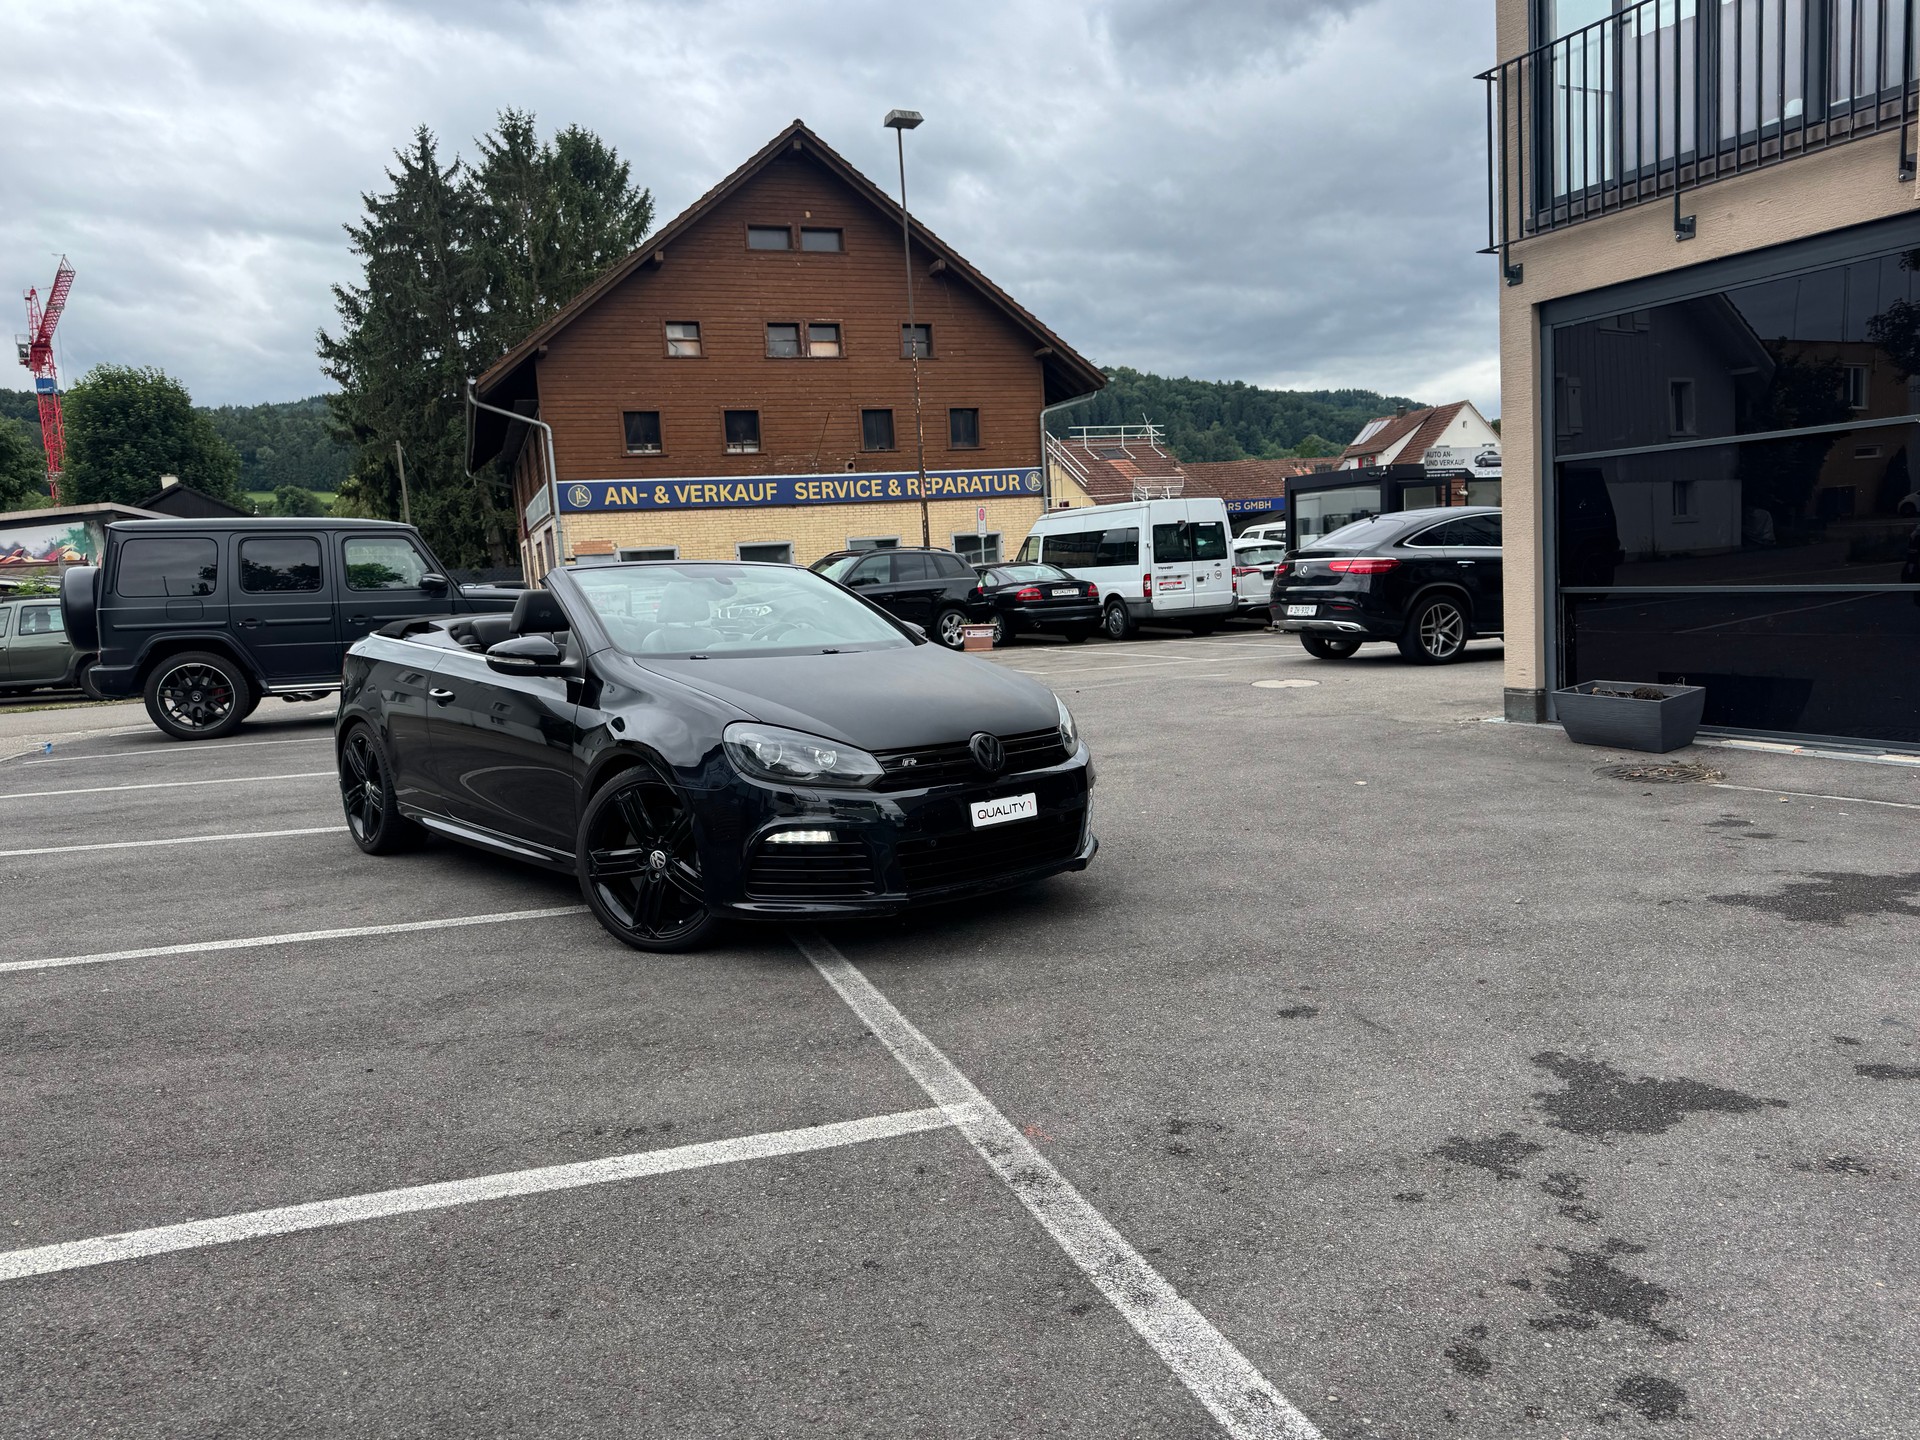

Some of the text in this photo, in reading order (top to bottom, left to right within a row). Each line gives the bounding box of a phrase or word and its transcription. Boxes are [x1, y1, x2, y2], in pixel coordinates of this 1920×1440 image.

[1443, 450, 1453, 458] AN-
[1440, 458, 1465, 466] VERKAUF
[604, 486, 648, 505] AN-
[654, 485, 671, 504] &
[674, 483, 777, 503] VERKAUF
[794, 479, 884, 500] SERVICE
[888, 479, 902, 496] &
[907, 473, 1021, 496] REPARATUR
[1243, 500, 1272, 510] GMBH
[977, 801, 1026, 820] QUALITY
